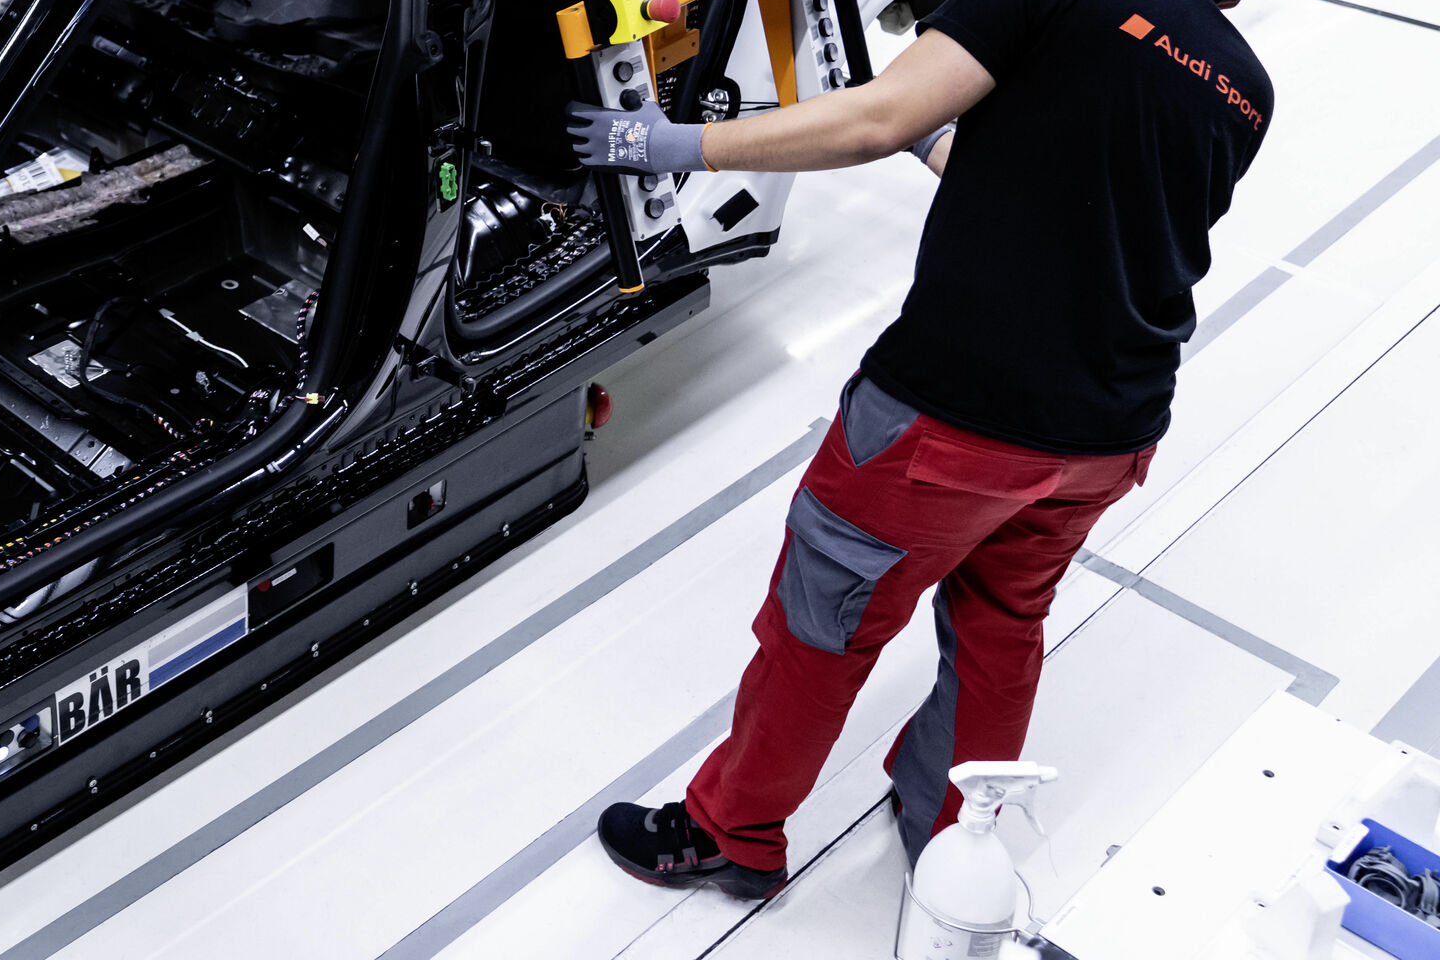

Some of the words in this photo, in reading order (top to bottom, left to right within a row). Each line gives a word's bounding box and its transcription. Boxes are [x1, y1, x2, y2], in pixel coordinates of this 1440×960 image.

[1153, 34, 1212, 81] Audi
[1215, 73, 1263, 131] Sport
[608, 119, 620, 162] MaxiFlex
[58, 658, 142, 739] BÄR
